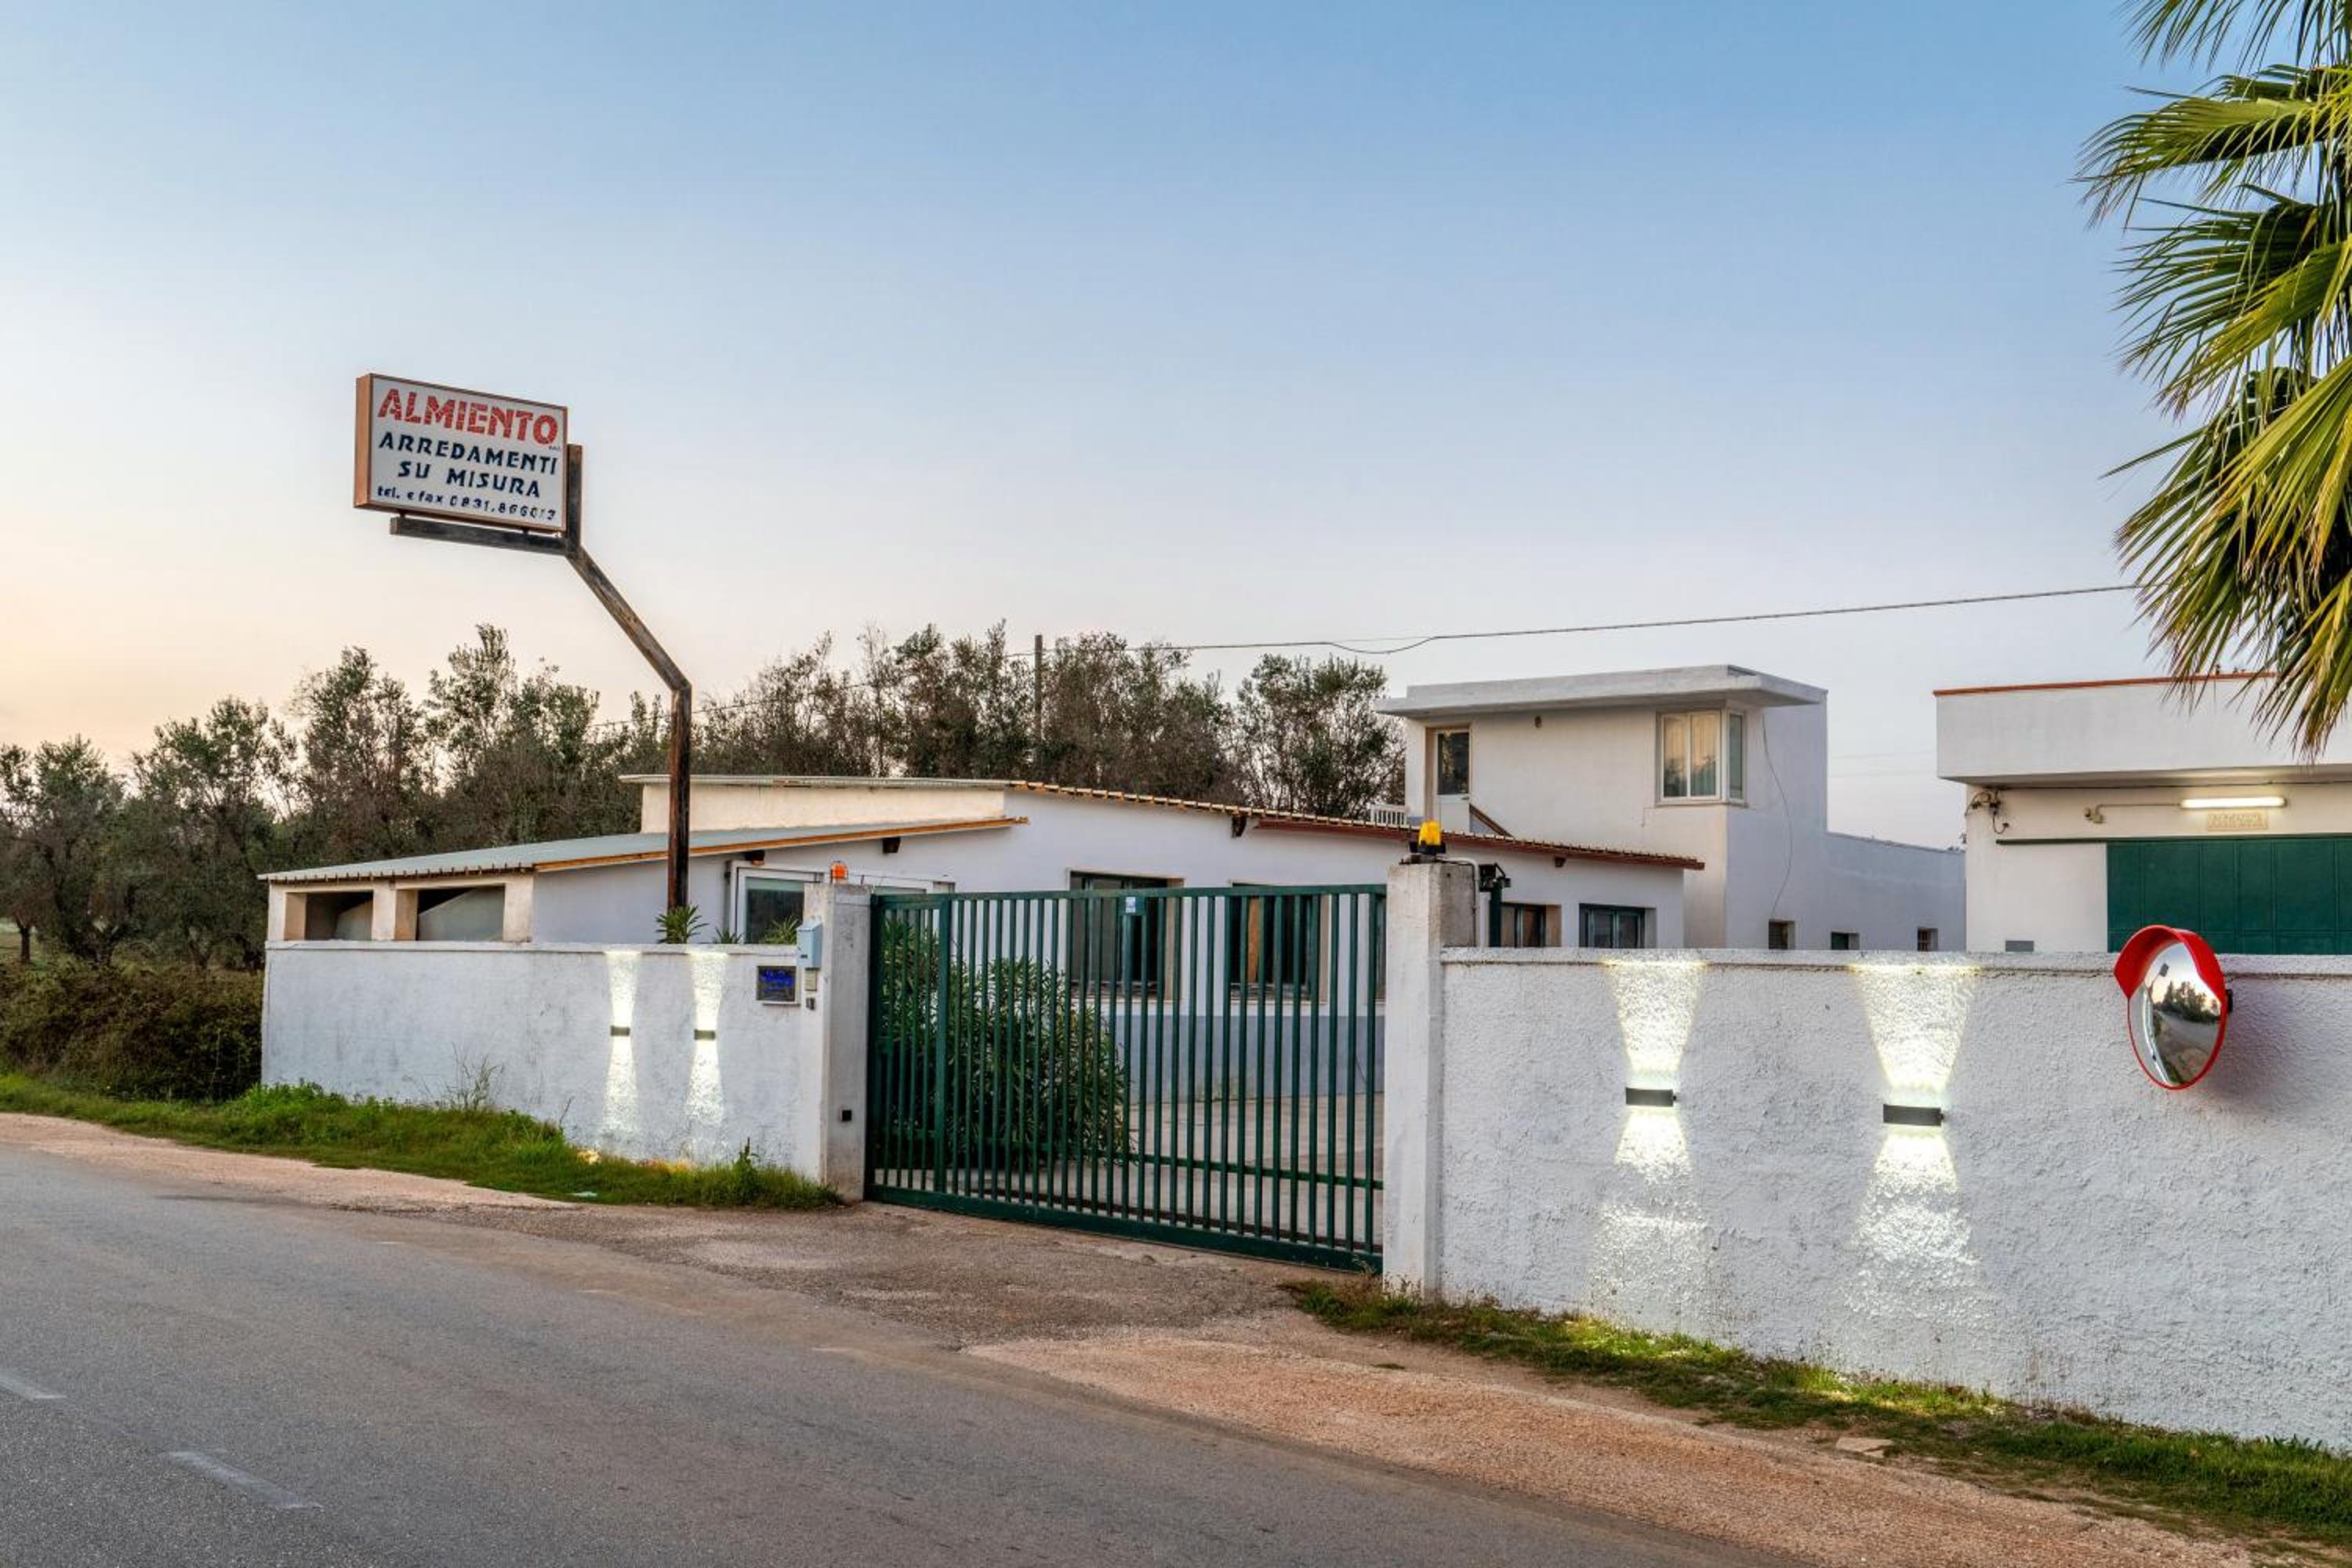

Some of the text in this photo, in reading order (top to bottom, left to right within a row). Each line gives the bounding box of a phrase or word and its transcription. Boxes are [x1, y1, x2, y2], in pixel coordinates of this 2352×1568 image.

[378, 388, 558, 445] ALMIENTO
[379, 431, 557, 475] ARREDAMENTI
[377, 485, 400, 499] tel.
[407, 492, 415, 500] e
[418, 491, 443, 503] fax
[397, 461, 540, 498] SU MISURA
